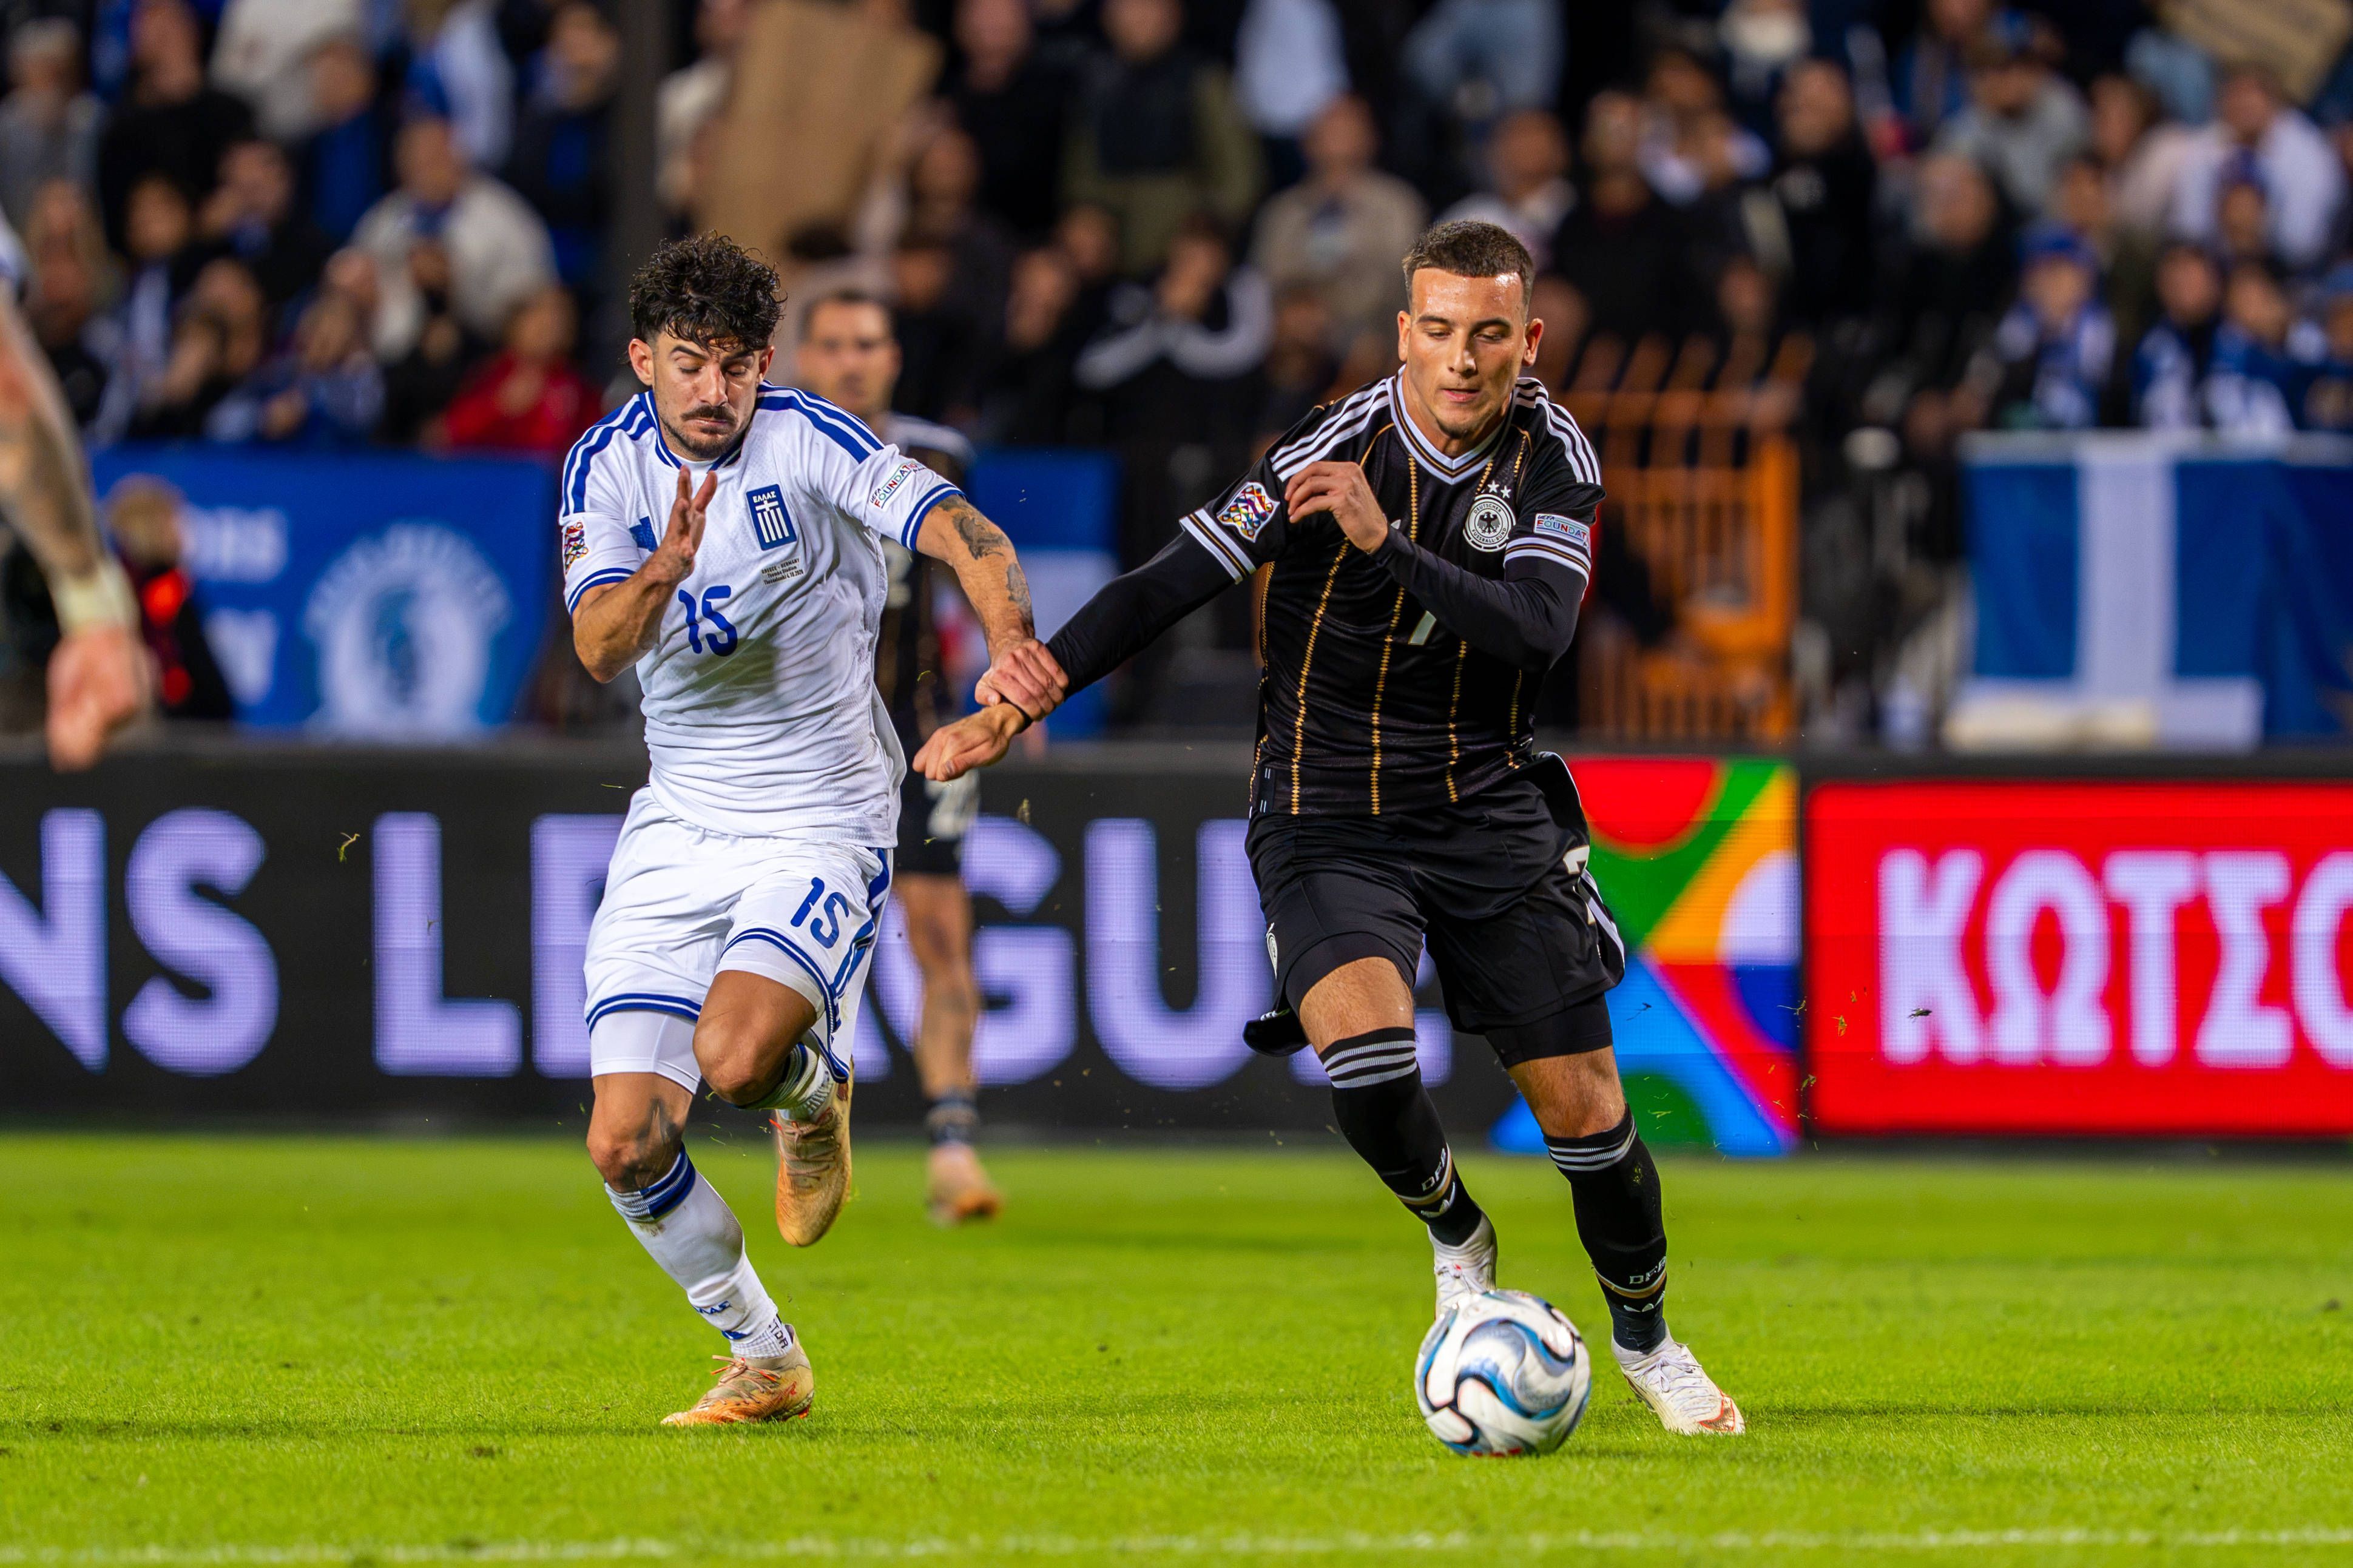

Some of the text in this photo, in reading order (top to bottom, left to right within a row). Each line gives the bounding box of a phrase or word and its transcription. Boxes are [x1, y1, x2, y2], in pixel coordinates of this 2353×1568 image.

[1473, 503, 1502, 514] DEUTSCHER
[780, 558, 800, 568] GERMANY
[678, 585, 738, 657] 15
[790, 877, 849, 949] 15
